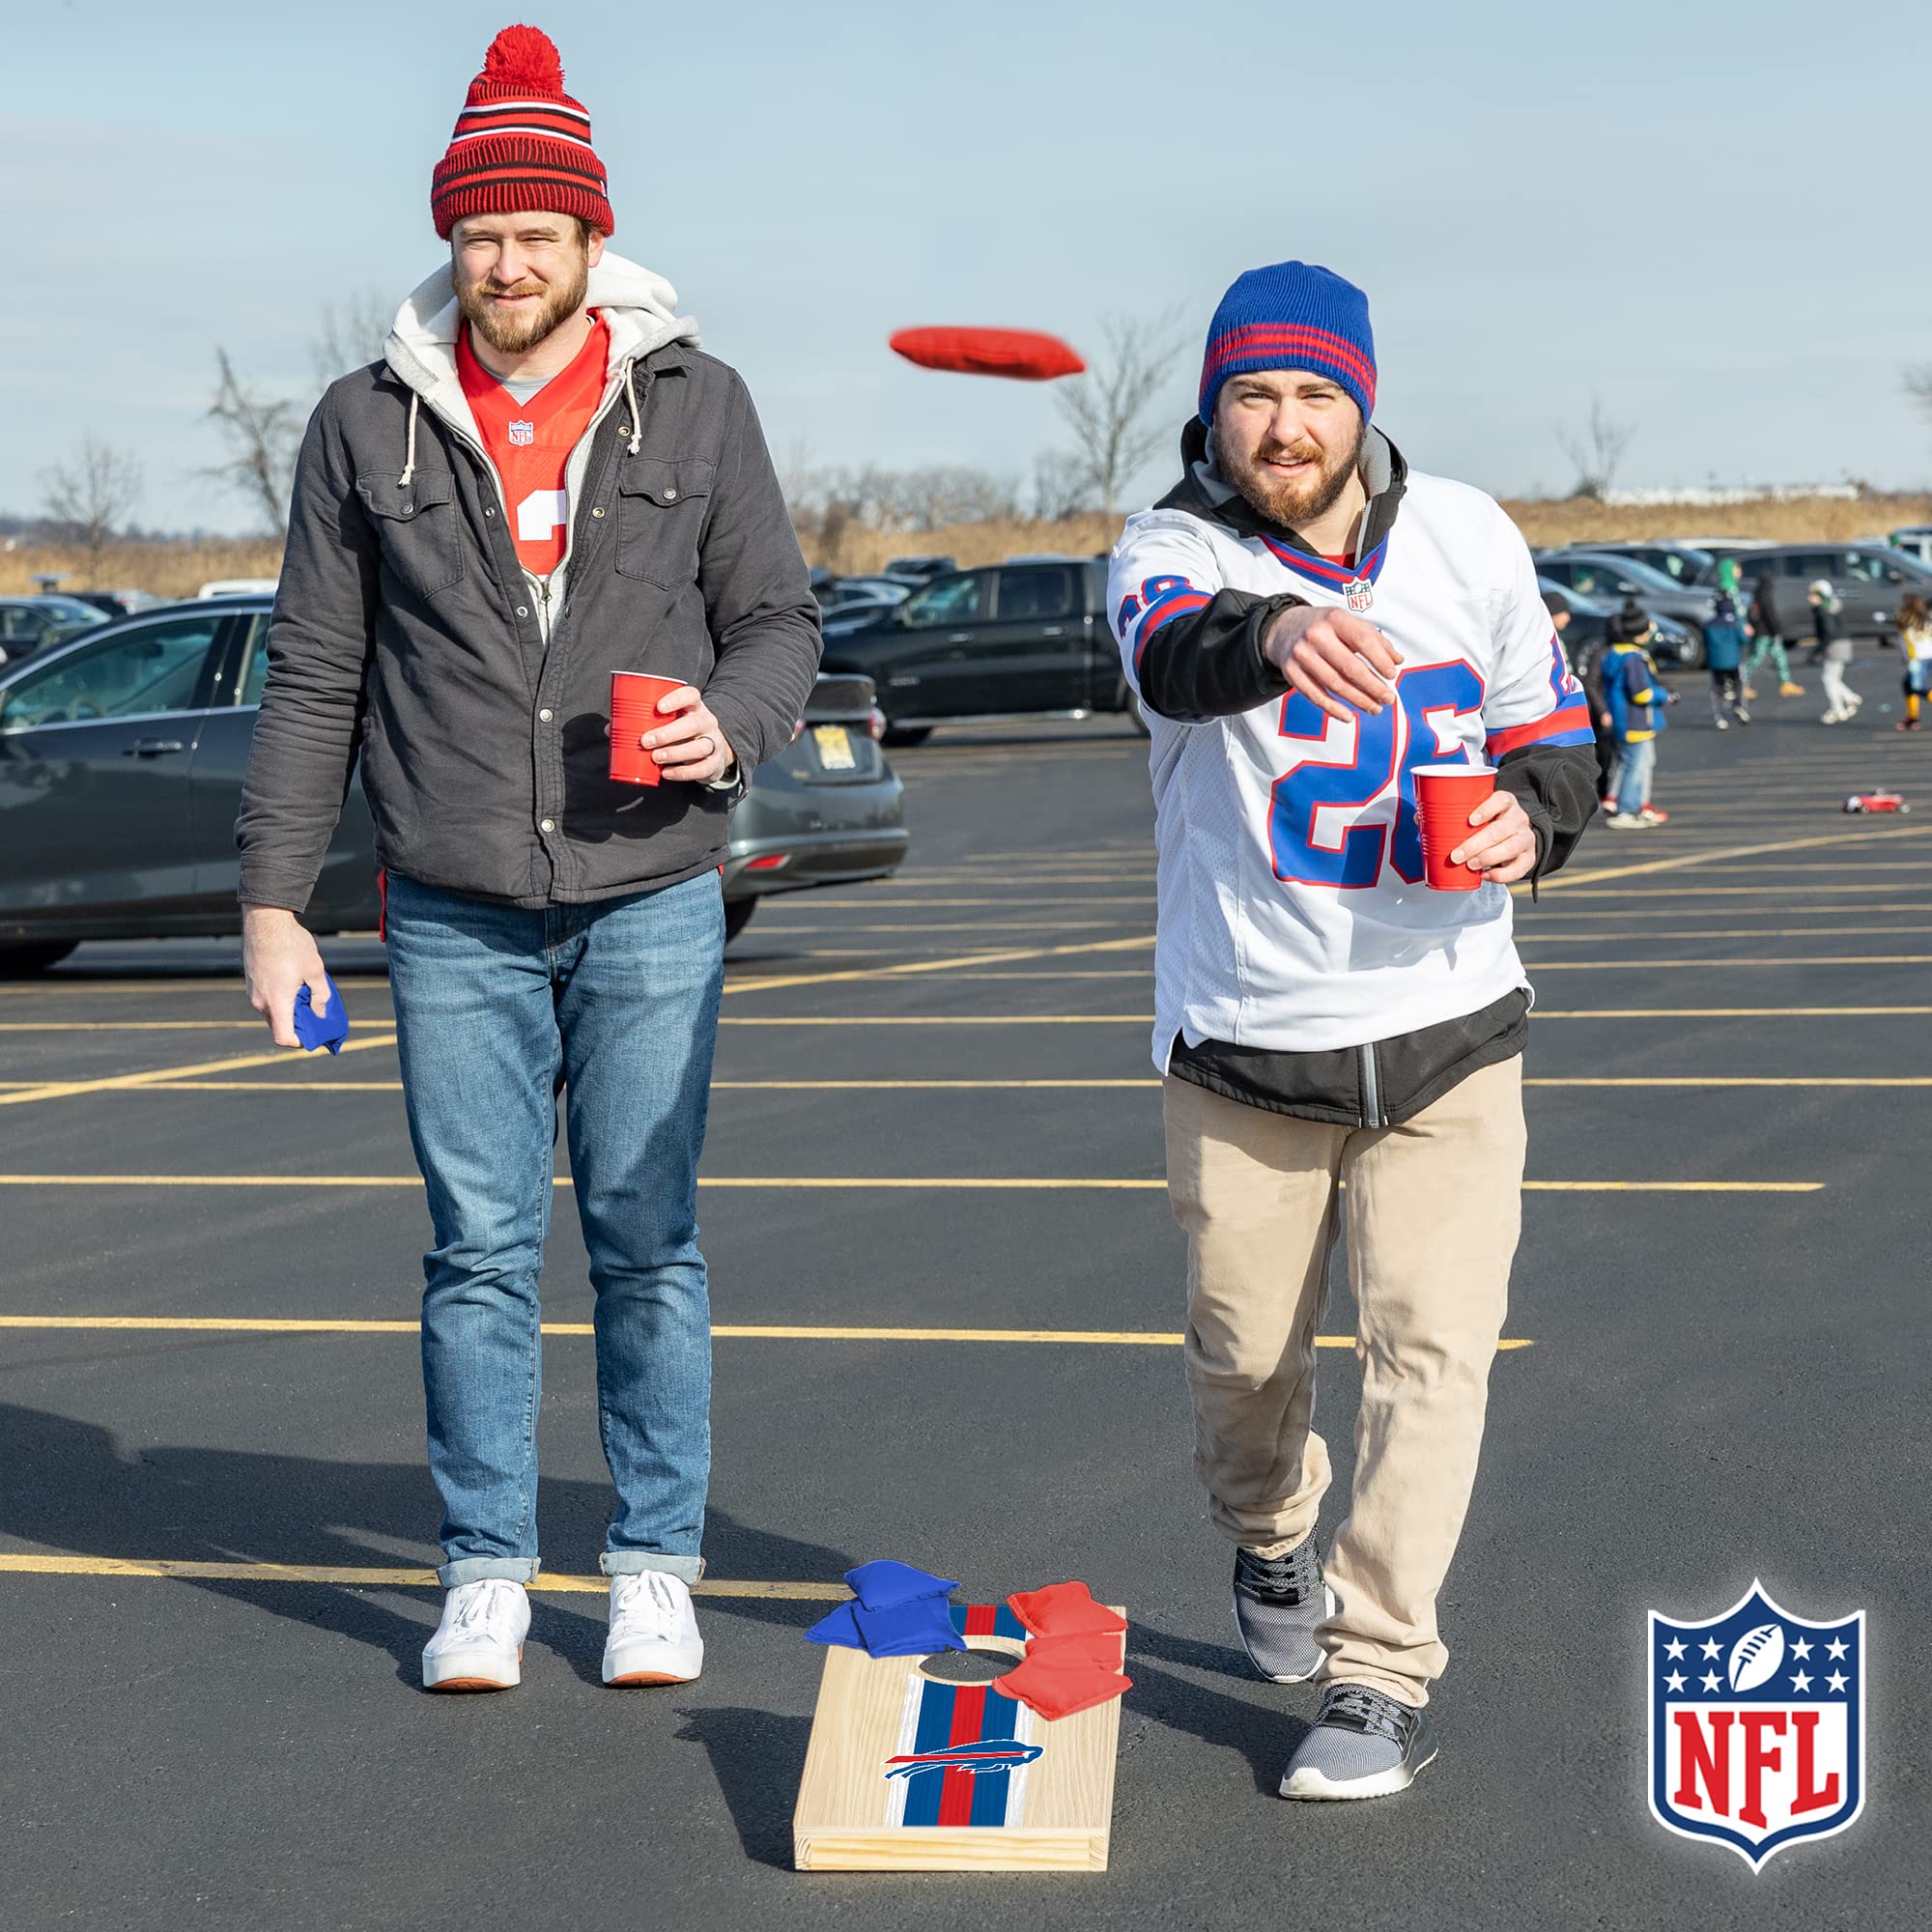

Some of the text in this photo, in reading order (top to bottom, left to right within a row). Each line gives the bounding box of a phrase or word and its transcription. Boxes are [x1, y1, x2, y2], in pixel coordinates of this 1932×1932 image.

[512, 430, 531, 442] NFL
[1350, 594, 1371, 610] NFL
[1267, 658, 1486, 889] 26
